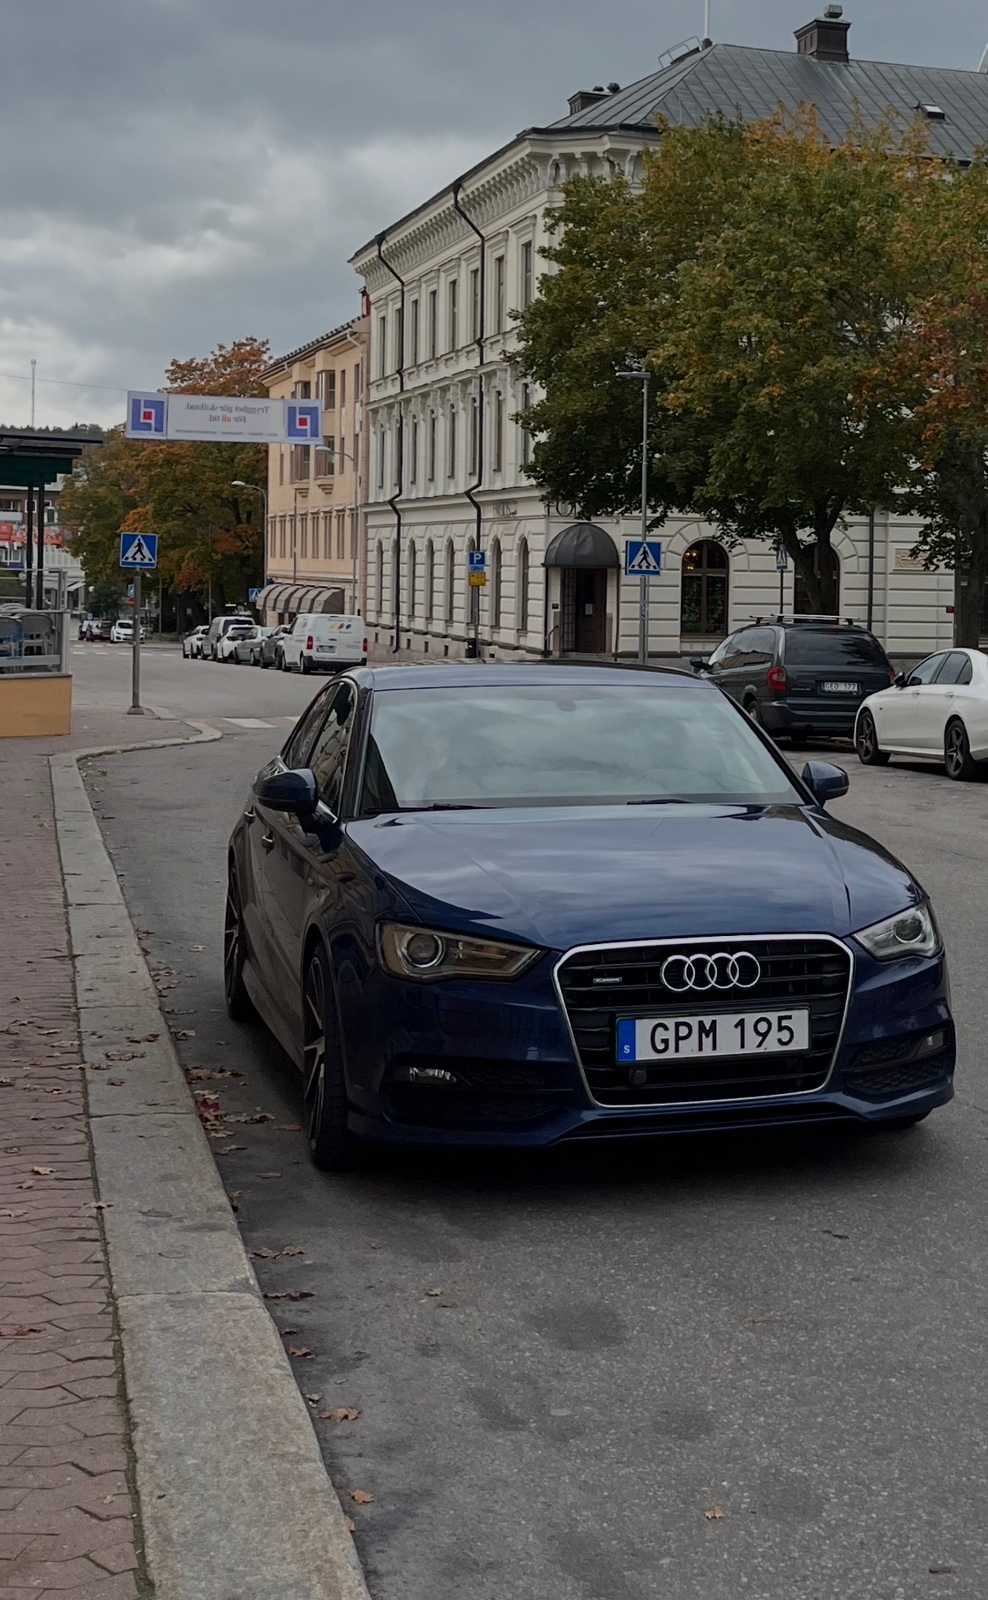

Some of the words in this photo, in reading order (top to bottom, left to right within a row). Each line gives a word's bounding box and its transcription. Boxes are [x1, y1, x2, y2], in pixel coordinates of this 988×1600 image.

[473, 553, 482, 564] P
[623, 1044, 631, 1054] S
[650, 1019, 718, 1054] GPM
[733, 1014, 795, 1050] 195
